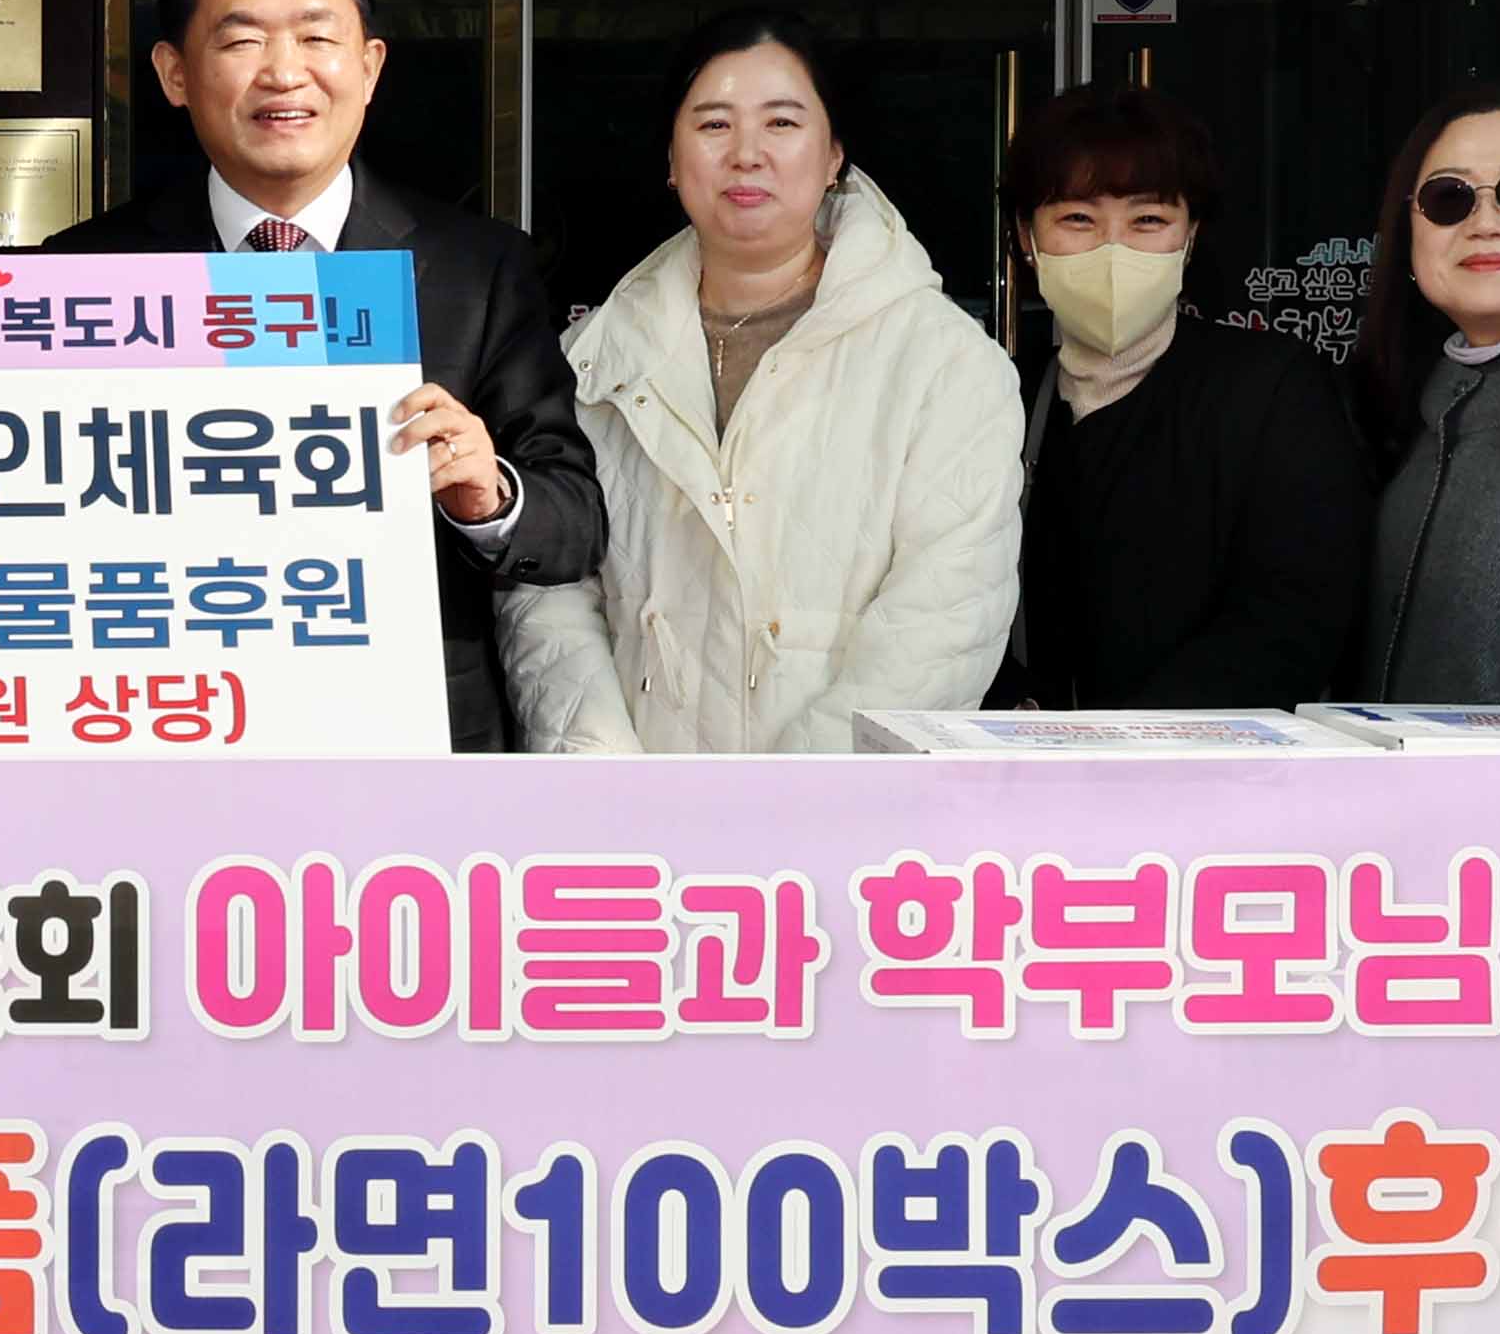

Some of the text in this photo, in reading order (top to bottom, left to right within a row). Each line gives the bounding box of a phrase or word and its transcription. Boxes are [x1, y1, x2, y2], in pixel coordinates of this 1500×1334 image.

[1245, 267, 1301, 301] 살고
[1302, 267, 1357, 301] 싶은
[65, 669, 249, 745] 상당)
[199, 859, 823, 1039] 아이들과
